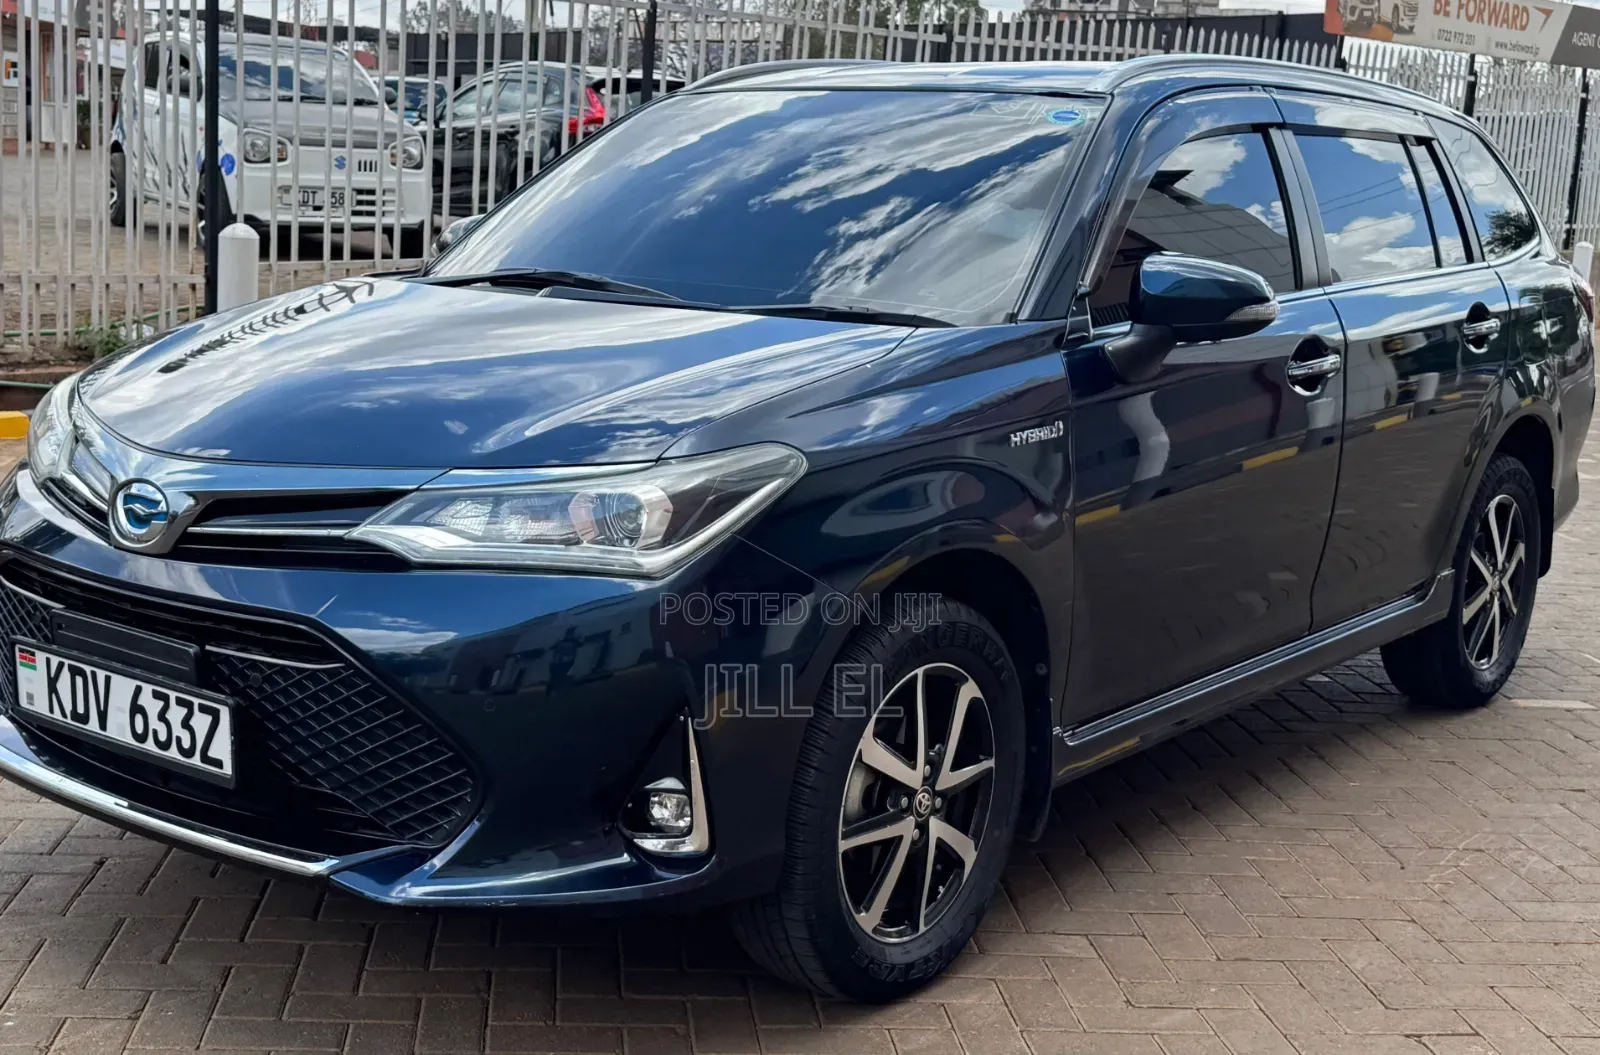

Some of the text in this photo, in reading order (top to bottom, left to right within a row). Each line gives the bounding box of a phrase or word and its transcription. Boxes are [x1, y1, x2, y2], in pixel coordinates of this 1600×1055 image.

[1433, 0, 1530, 31] BE FORWARD
[1437, 28, 1453, 42] 0722
[1571, 31, 1597, 48] AGENT
[294, 190, 318, 204] DT
[1010, 425, 1056, 447] HYBRID
[45, 656, 224, 770] KDV 633Z
